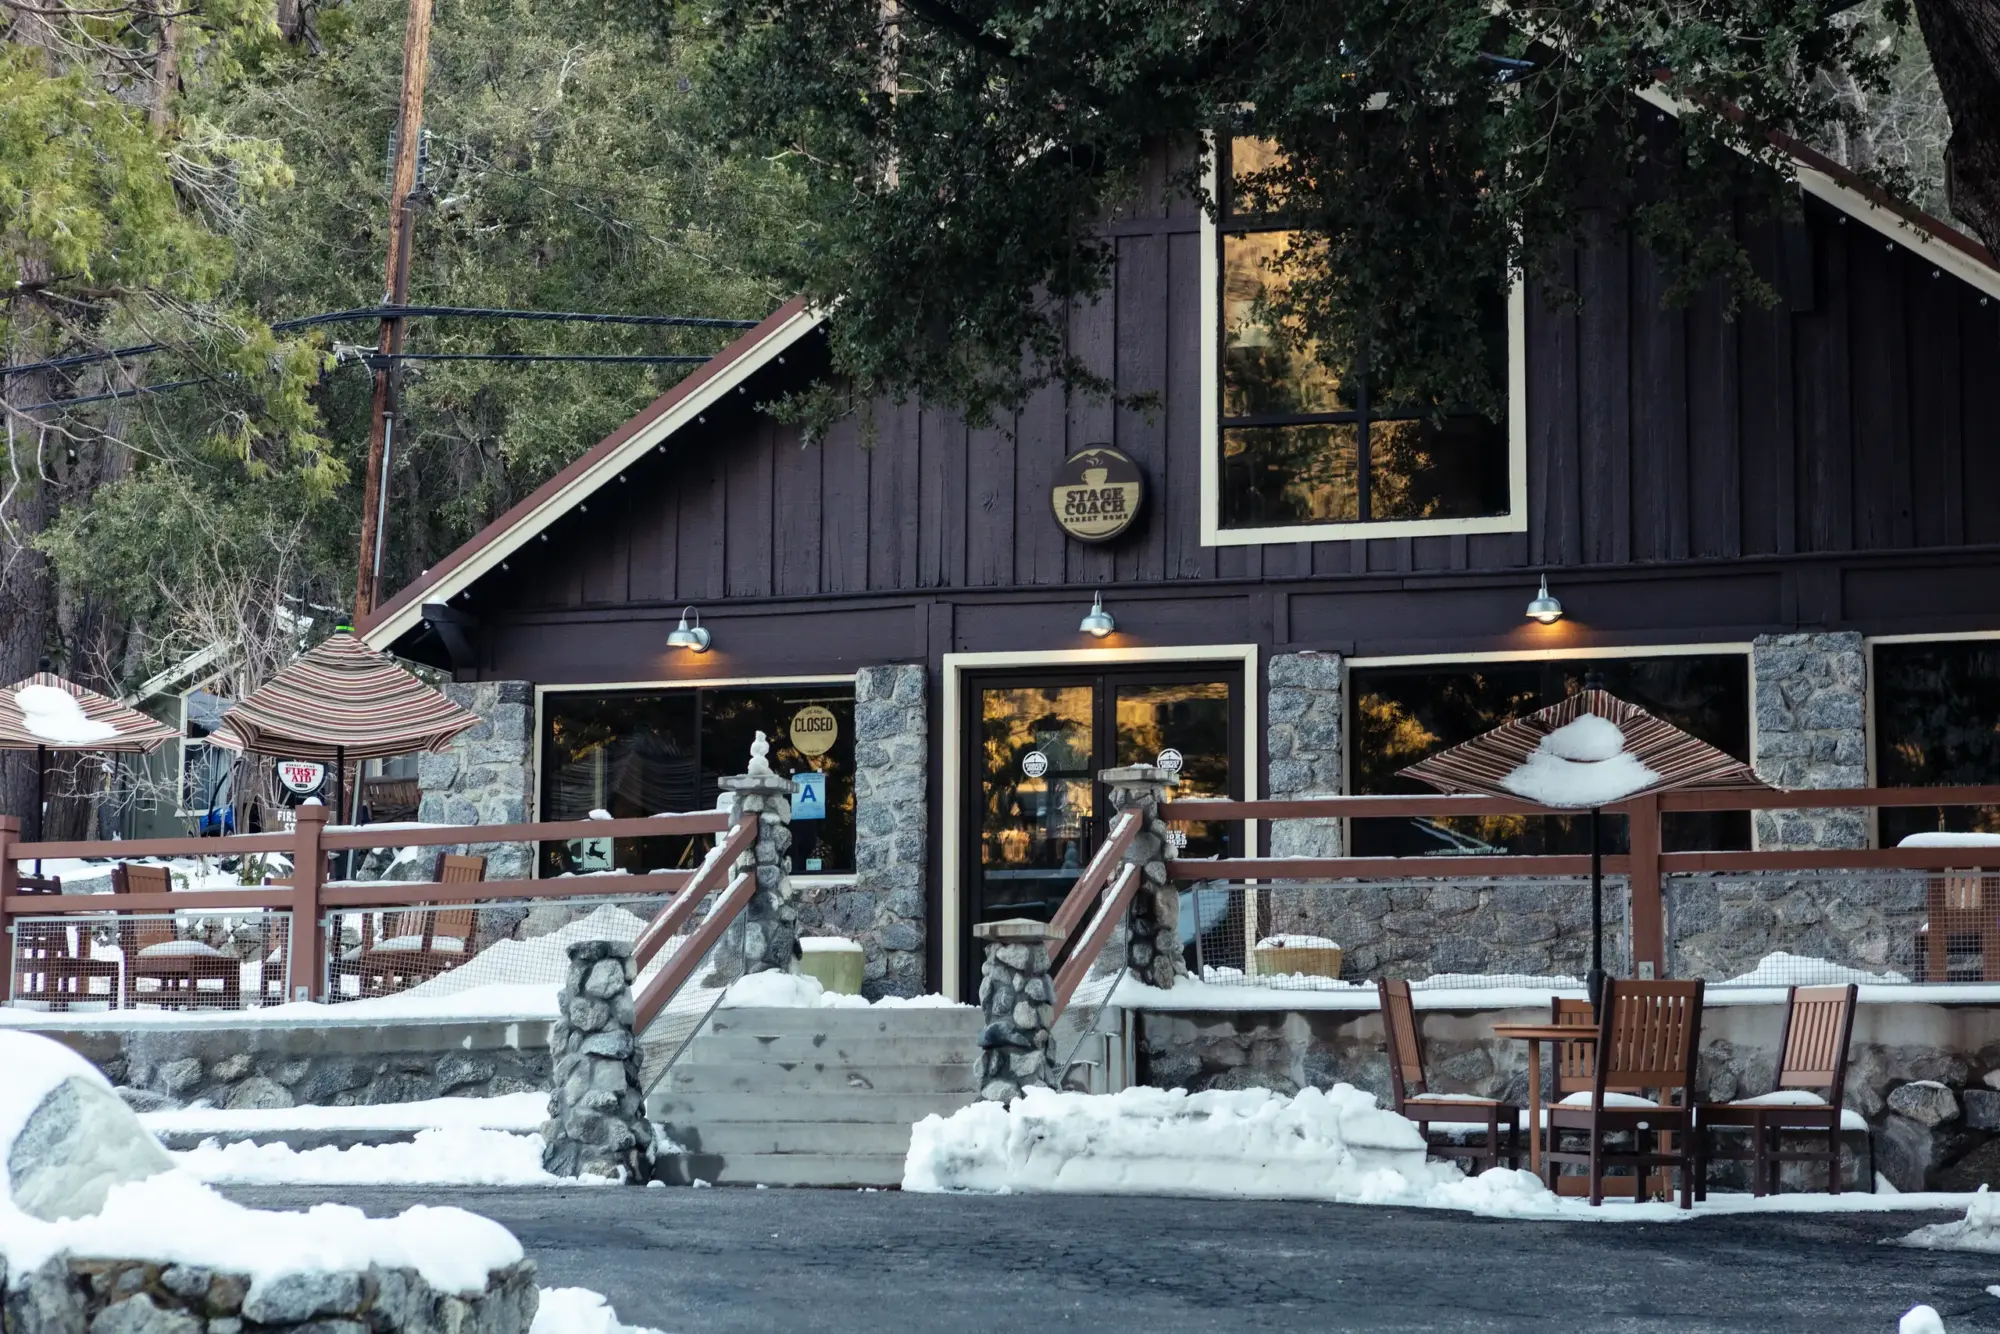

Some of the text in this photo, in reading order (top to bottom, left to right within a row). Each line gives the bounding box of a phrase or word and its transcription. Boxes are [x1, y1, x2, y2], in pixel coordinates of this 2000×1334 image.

[1066, 487, 1124, 503] STAGE
[1065, 500, 1125, 516] COACH
[1064, 513, 1128, 523] FOREST HOME
[794, 717, 833, 732] CLOSED
[285, 767, 318, 776] FIRST
[291, 774, 312, 783] AID
[800, 784, 817, 803] A
